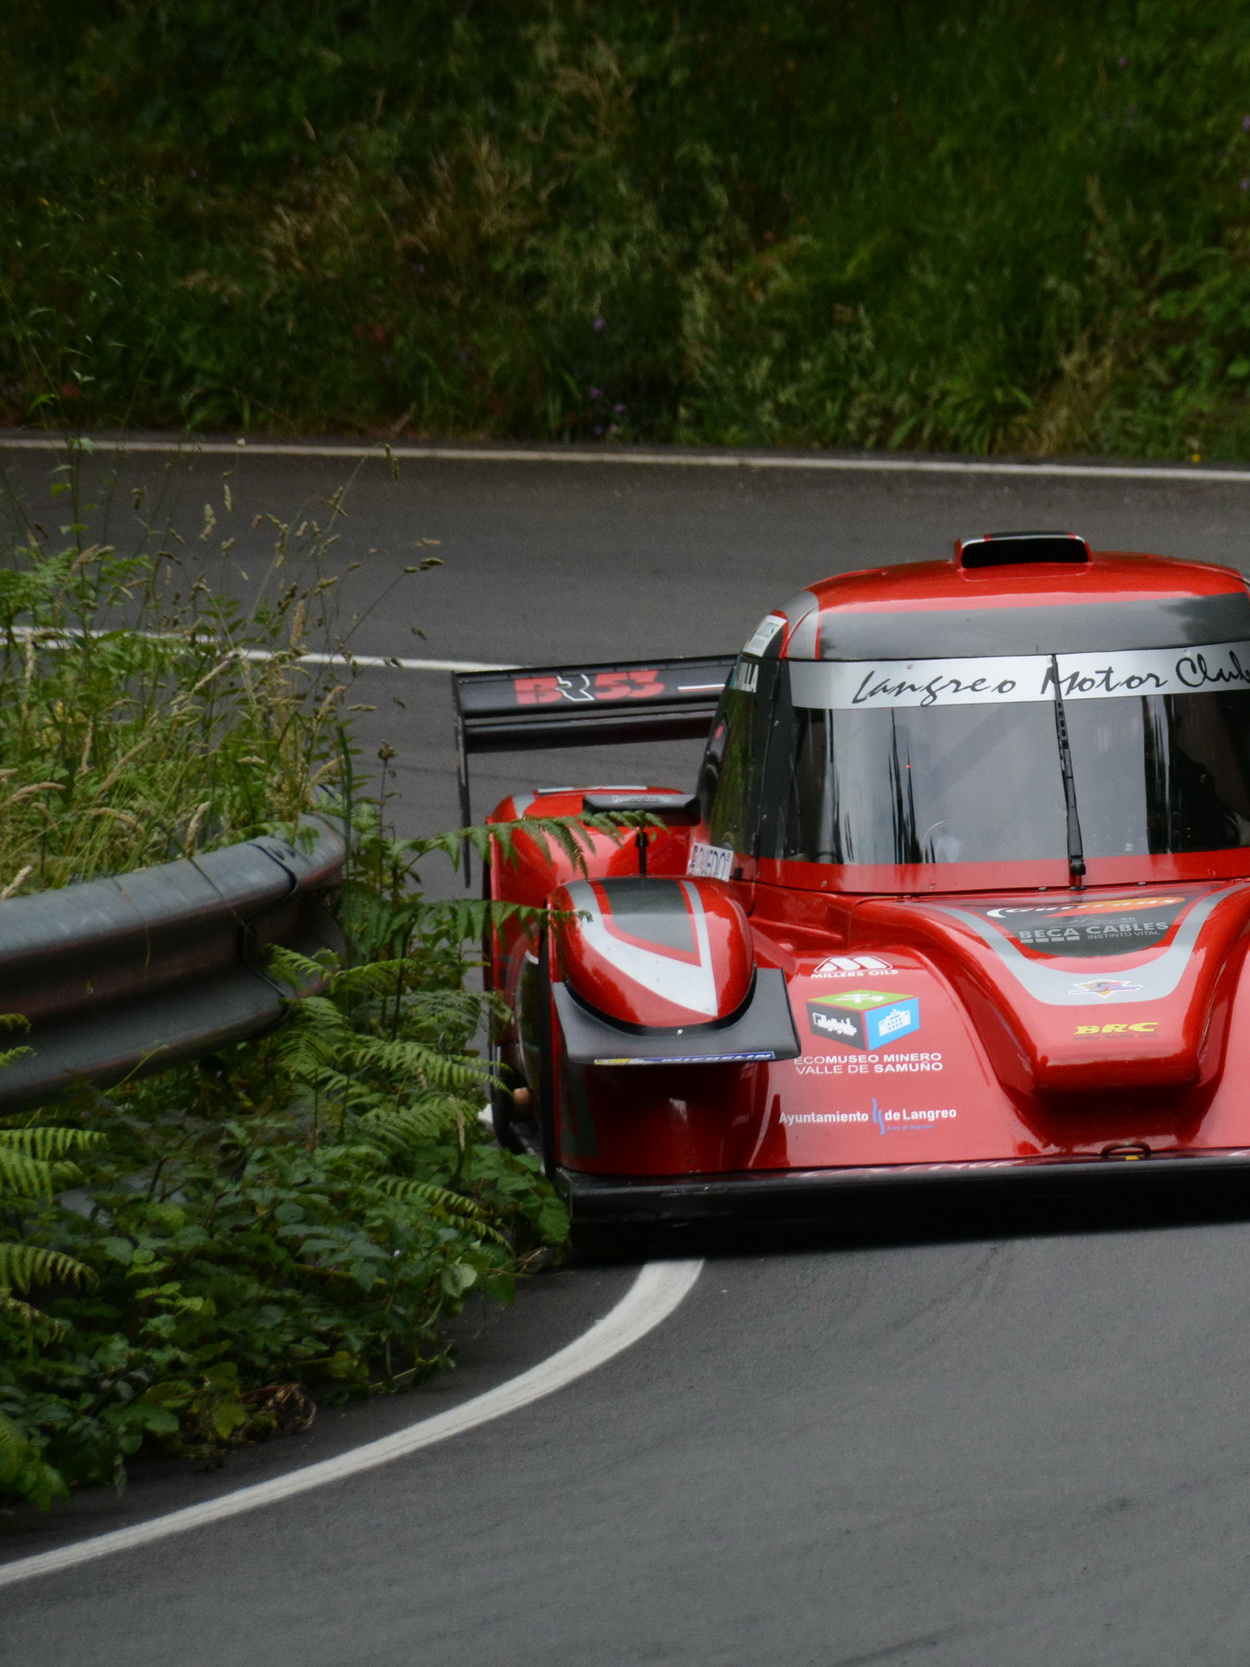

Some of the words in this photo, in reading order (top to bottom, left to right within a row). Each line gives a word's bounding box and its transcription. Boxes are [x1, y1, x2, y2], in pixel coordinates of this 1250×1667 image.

[852, 670, 1017, 707] Langreo
[1040, 665, 1168, 696] Motor
[1019, 927, 1080, 940] BECA
[1085, 921, 1169, 935] CABLES
[1087, 931, 1132, 940] INSTINTO
[1134, 929, 1161, 938] VITAL
[810, 971, 865, 979] MILLERS
[868, 968, 900, 977] OILS
[1074, 1022, 1159, 1035] BRC
[794, 1053, 880, 1066] ECOMUSEO
[883, 1052, 942, 1063] MINERO
[795, 1064, 844, 1075] VALLE
[848, 1063, 870, 1074] DE
[874, 1060, 944, 1074] SAMUÑO
[779, 1110, 869, 1126] Ayuntamiento
[885, 1109, 901, 1121] de
[902, 1108, 957, 1122] Langreo
